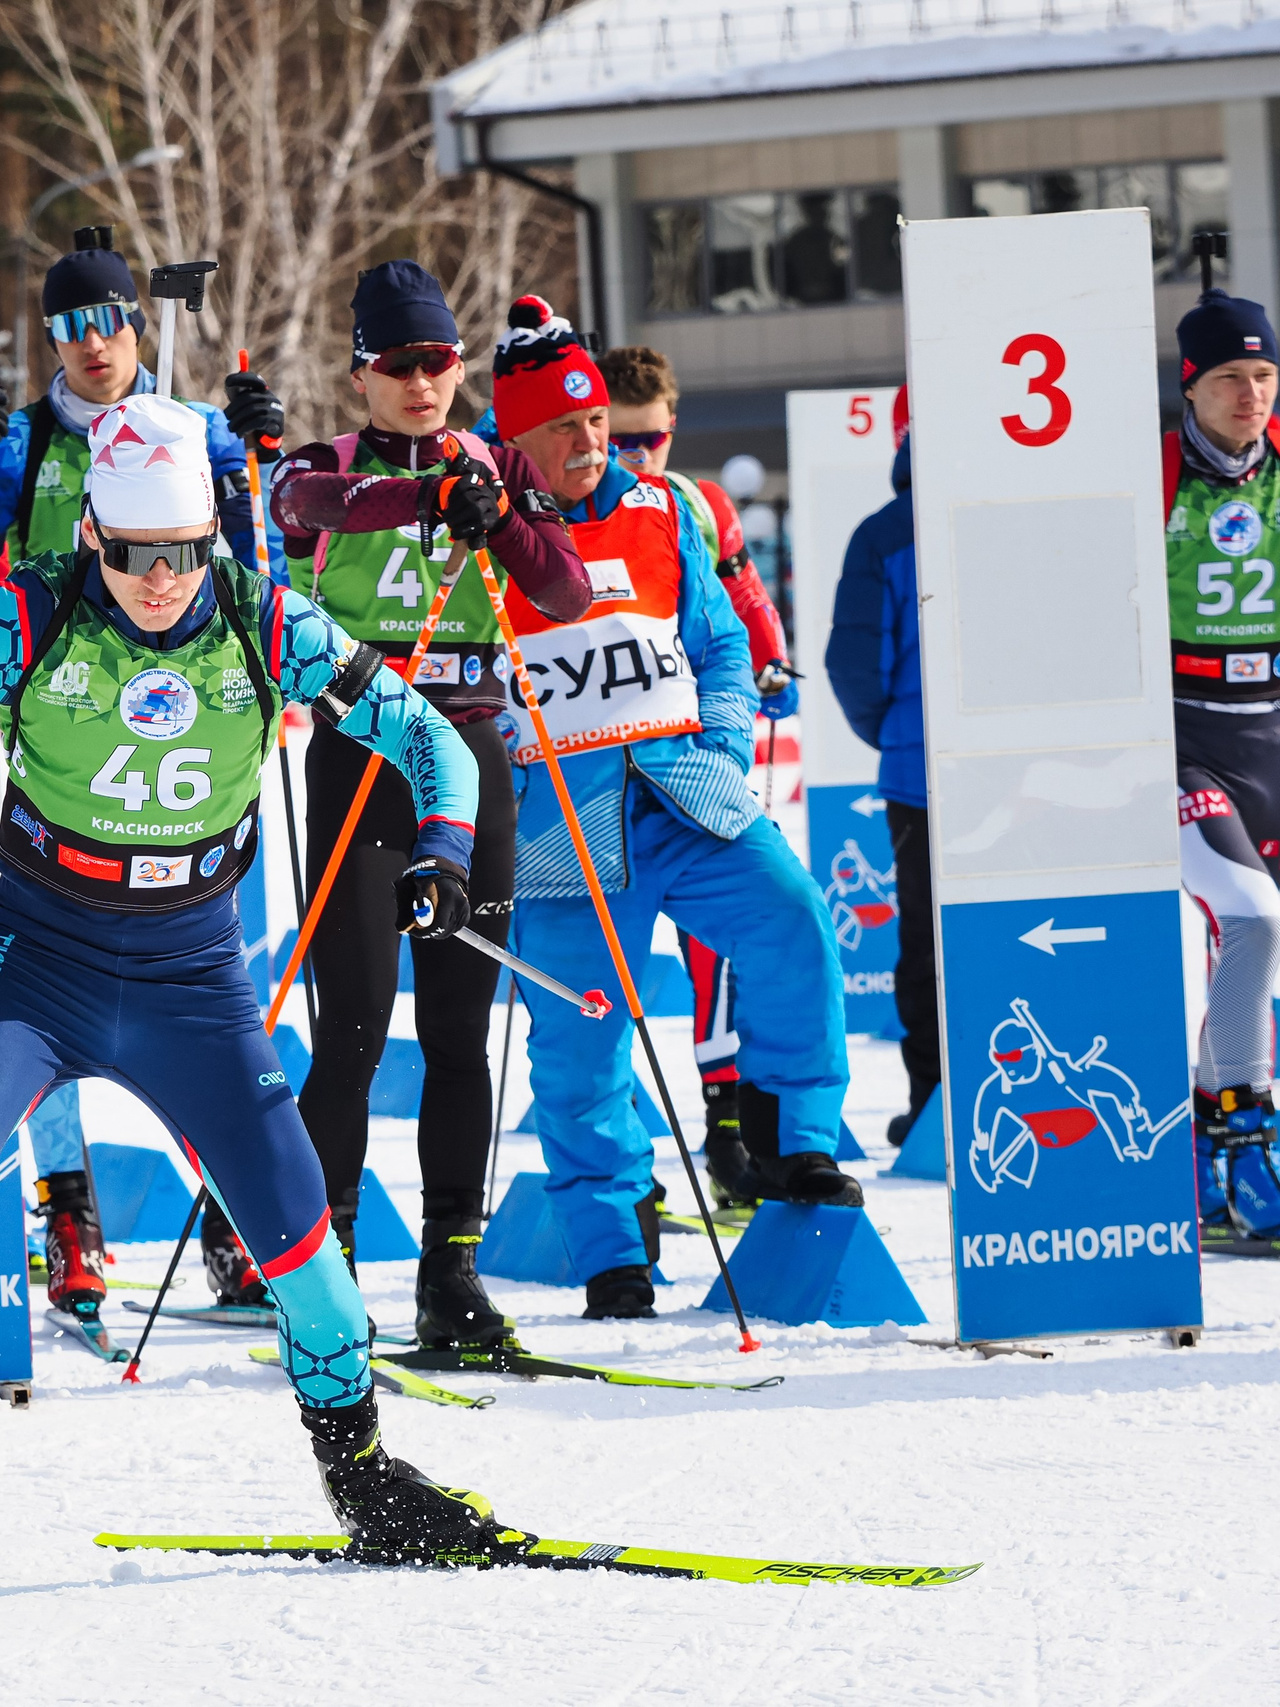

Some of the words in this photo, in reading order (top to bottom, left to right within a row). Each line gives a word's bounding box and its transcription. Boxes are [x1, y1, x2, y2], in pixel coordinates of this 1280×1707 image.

[1000, 333, 1072, 447] 3
[846, 394, 875, 438] 5
[632, 481, 661, 506] 35
[1196, 559, 1276, 617] 52
[379, 620, 466, 633] КРАСНЯРСК
[1196, 624, 1276, 637] КРАСНОЯРСК
[127, 670, 167, 689] ПЕРВЕНСТВО
[166, 671, 191, 690] РОССИИ
[222, 668, 248, 679] СПО
[89, 743, 213, 812] 46
[1180, 802, 1230, 823] IUM
[90, 816, 205, 836] КРАСНОЯРСК
[76, 853, 119, 867] КРАСНОЯРСКИЙ
[961, 1221, 1194, 1269] КРАСНОЯРСК
[435, 1553, 491, 1565] FISCHER
[753, 1563, 916, 1582] FISCHER
